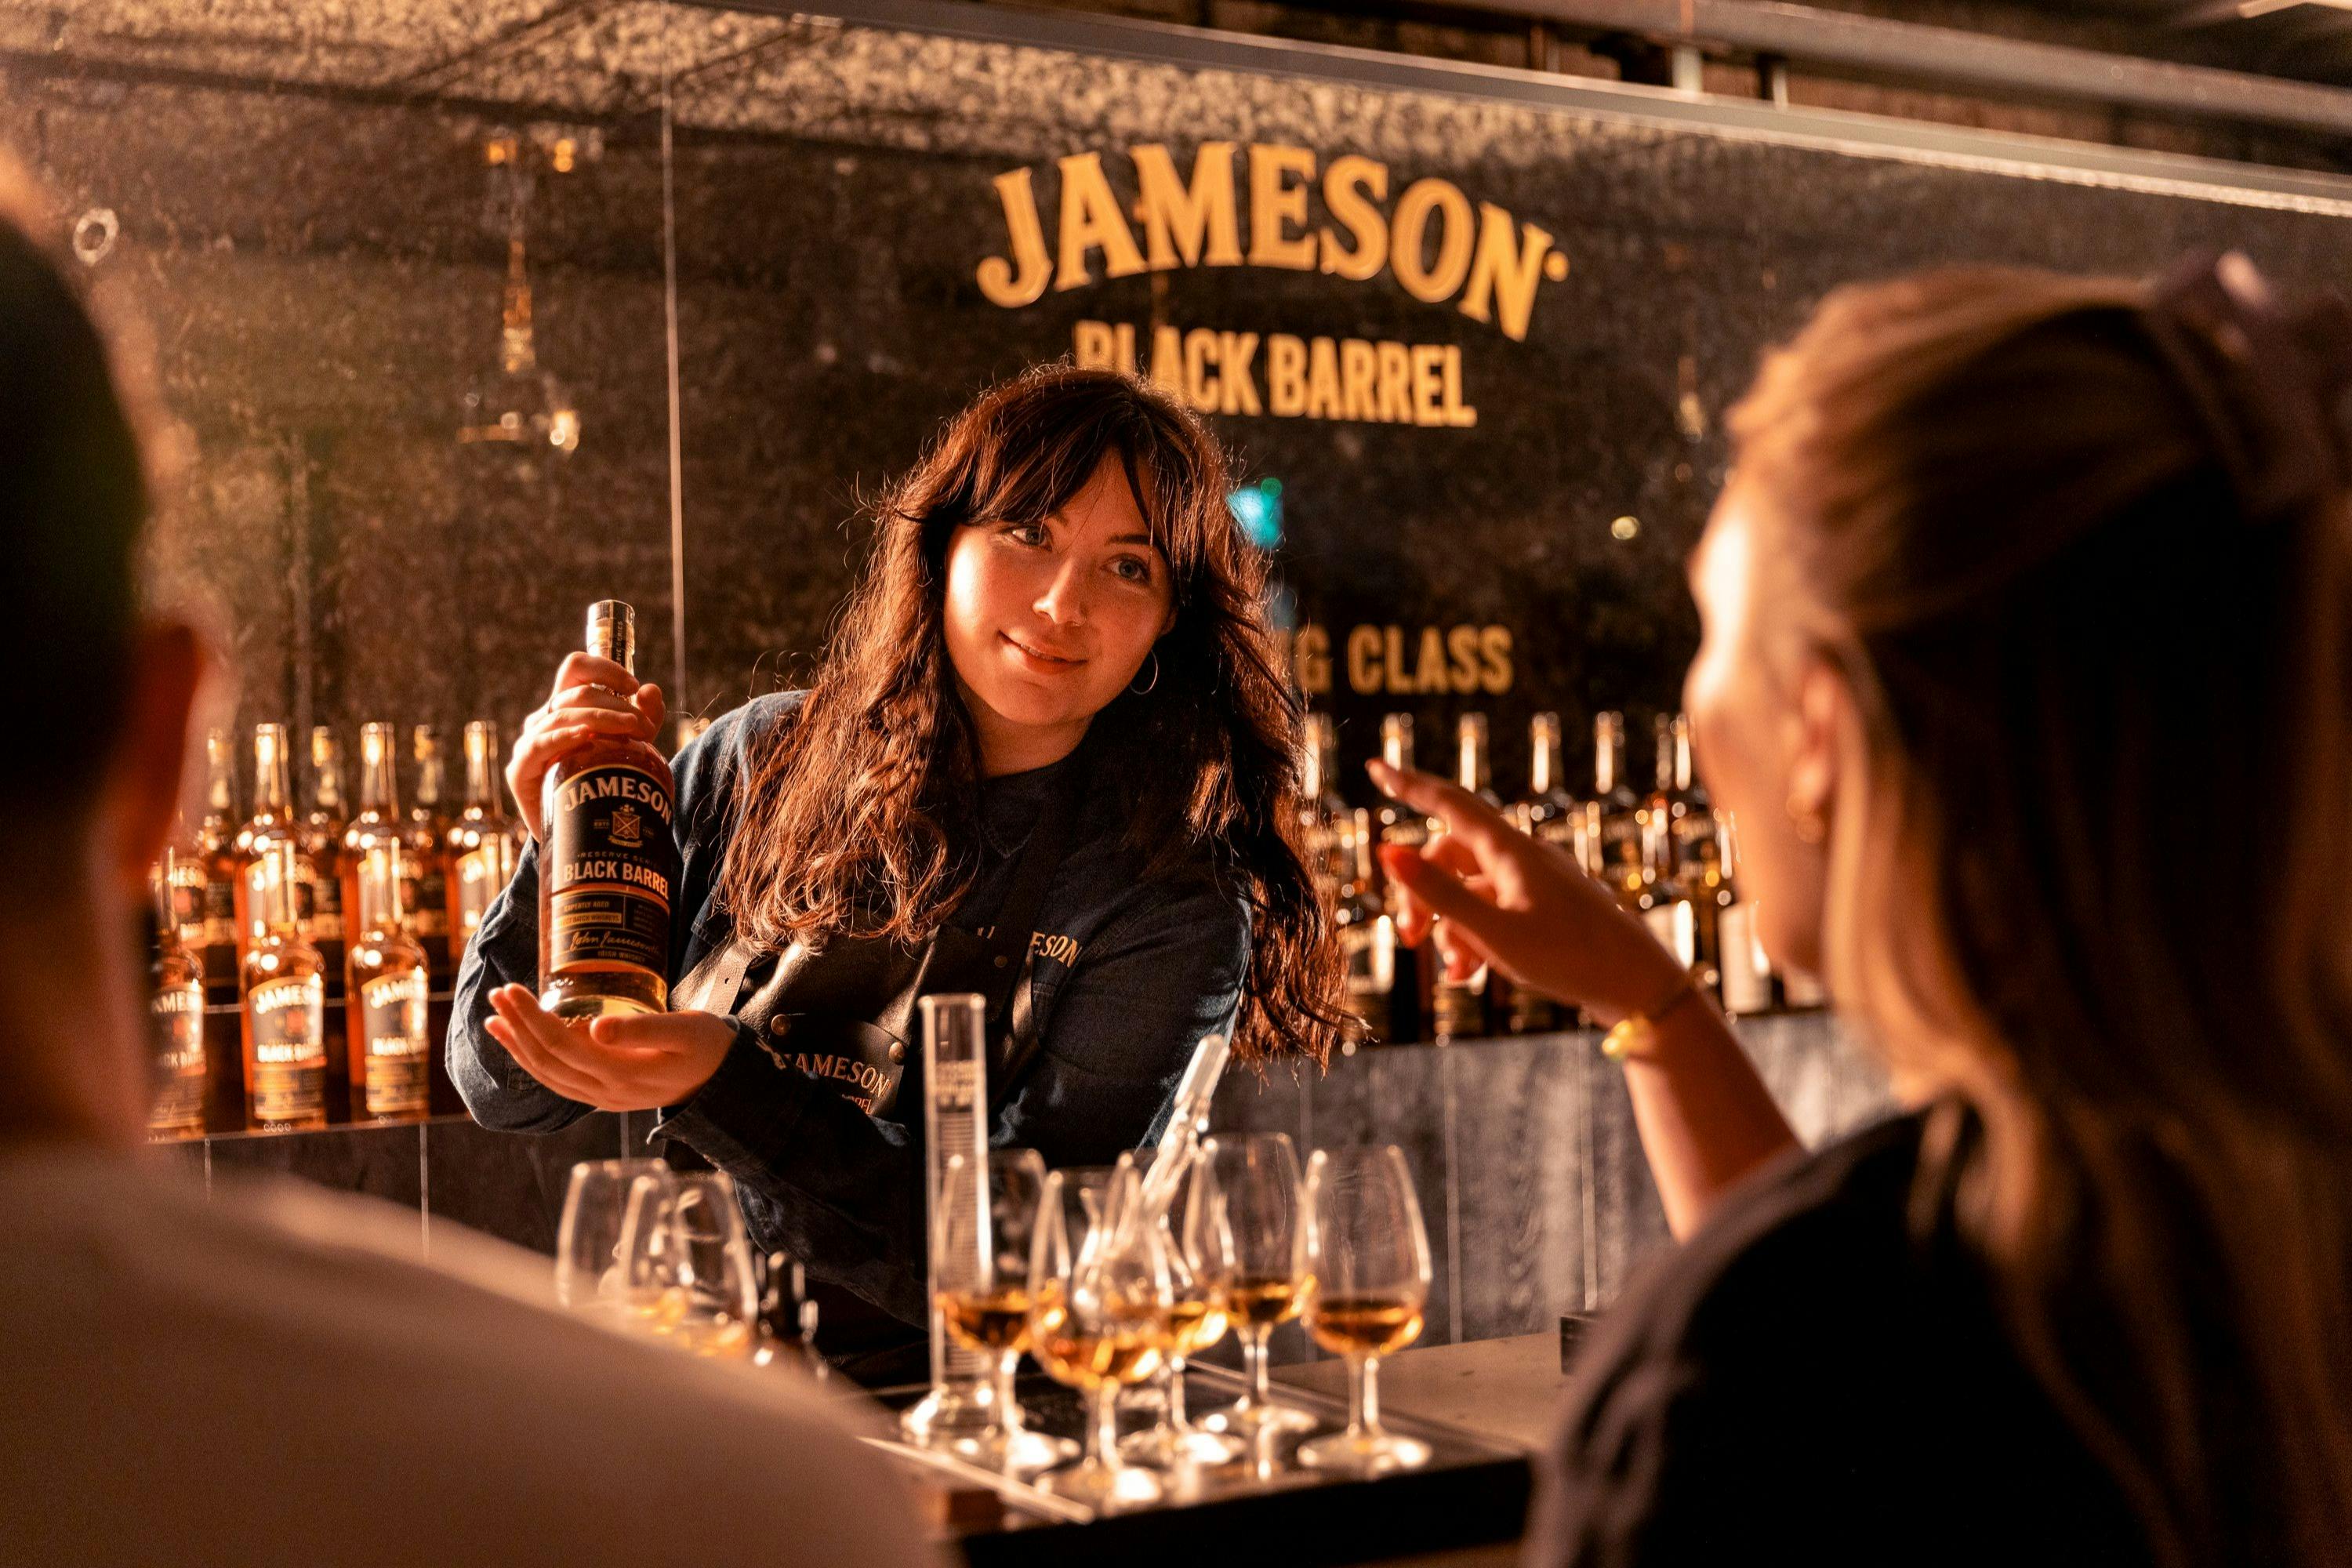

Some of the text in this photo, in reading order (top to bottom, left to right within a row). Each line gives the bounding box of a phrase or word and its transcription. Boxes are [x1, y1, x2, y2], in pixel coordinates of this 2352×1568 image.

[976, 141, 1555, 343] JAMESON
[1268, 333, 1478, 428] BARREL
[1347, 623, 1514, 696] CLASS
[564, 776, 673, 826] JAMESON
[564, 860, 670, 900] BLACK BARREL
[784, 1053, 892, 1100] AMESON
